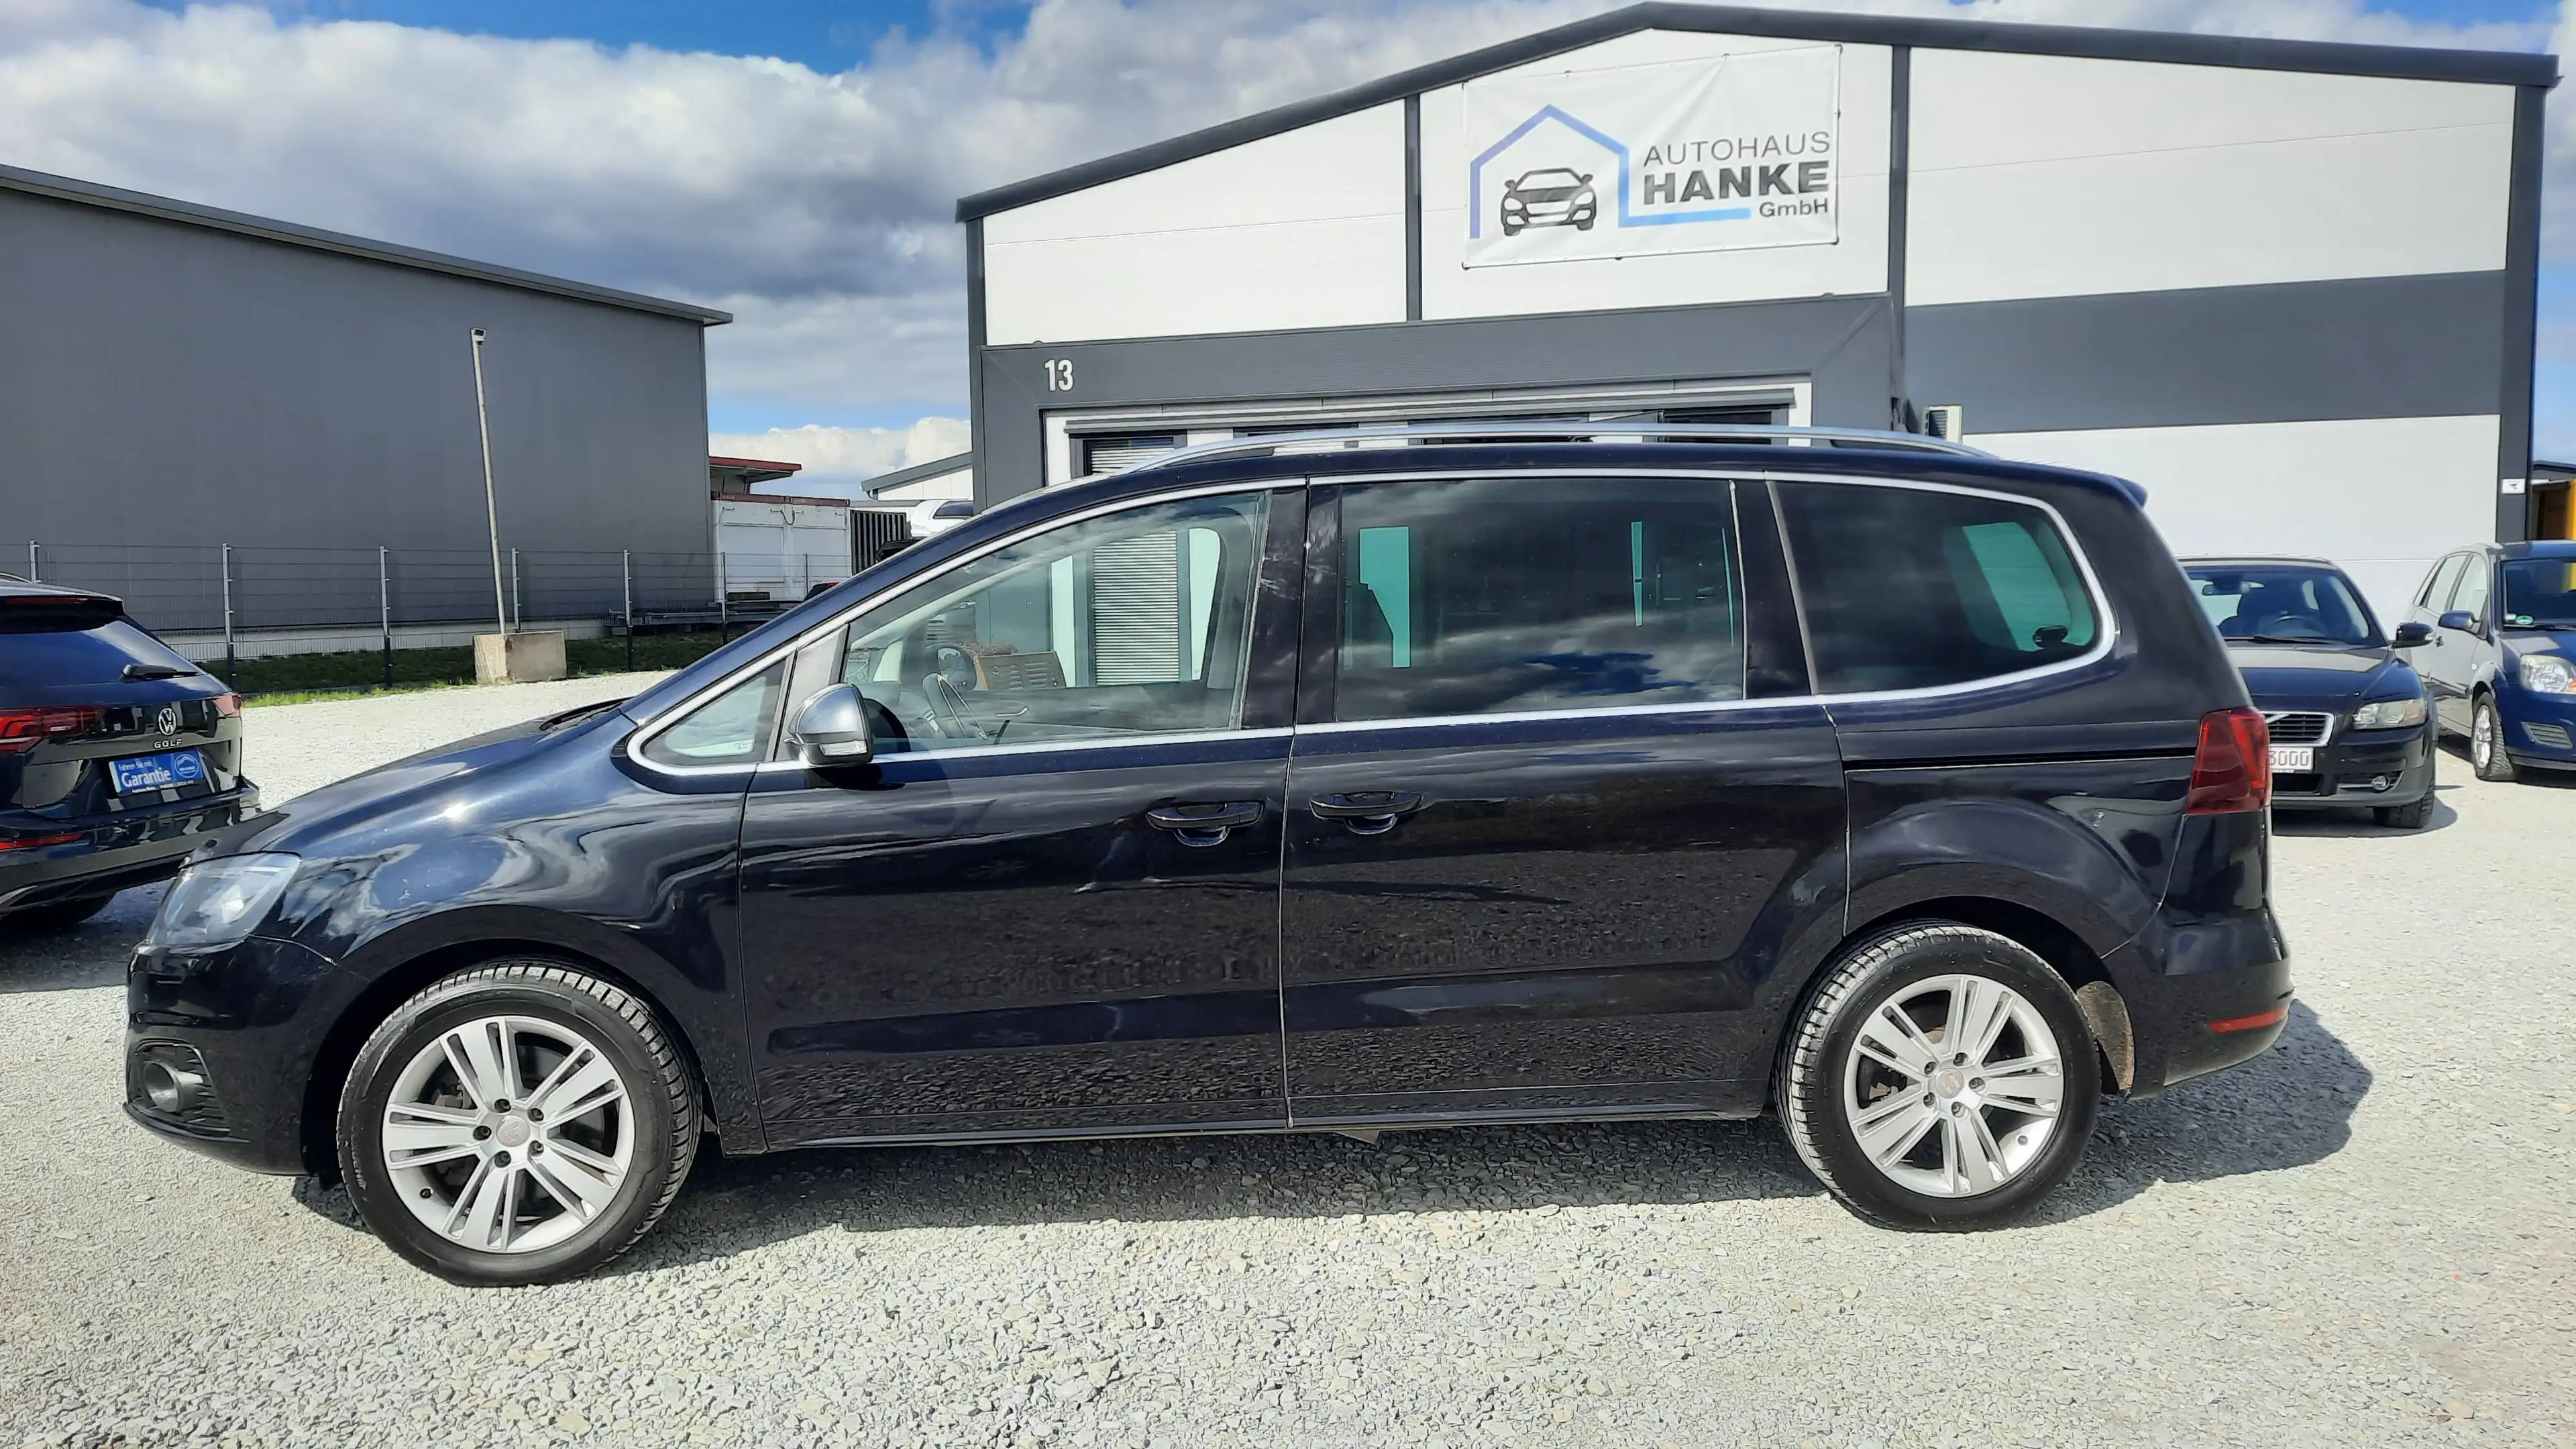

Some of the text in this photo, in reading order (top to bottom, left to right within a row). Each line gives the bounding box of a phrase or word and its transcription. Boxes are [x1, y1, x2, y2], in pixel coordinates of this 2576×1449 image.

[1643, 131, 1831, 168] AUTOHAUS
[1644, 160, 1830, 205] HANKE
[1759, 197, 1829, 218] GmbH
[1044, 358, 1074, 392] 13
[154, 739, 182, 749] GOLF
[121, 767, 172, 788] Garantie
